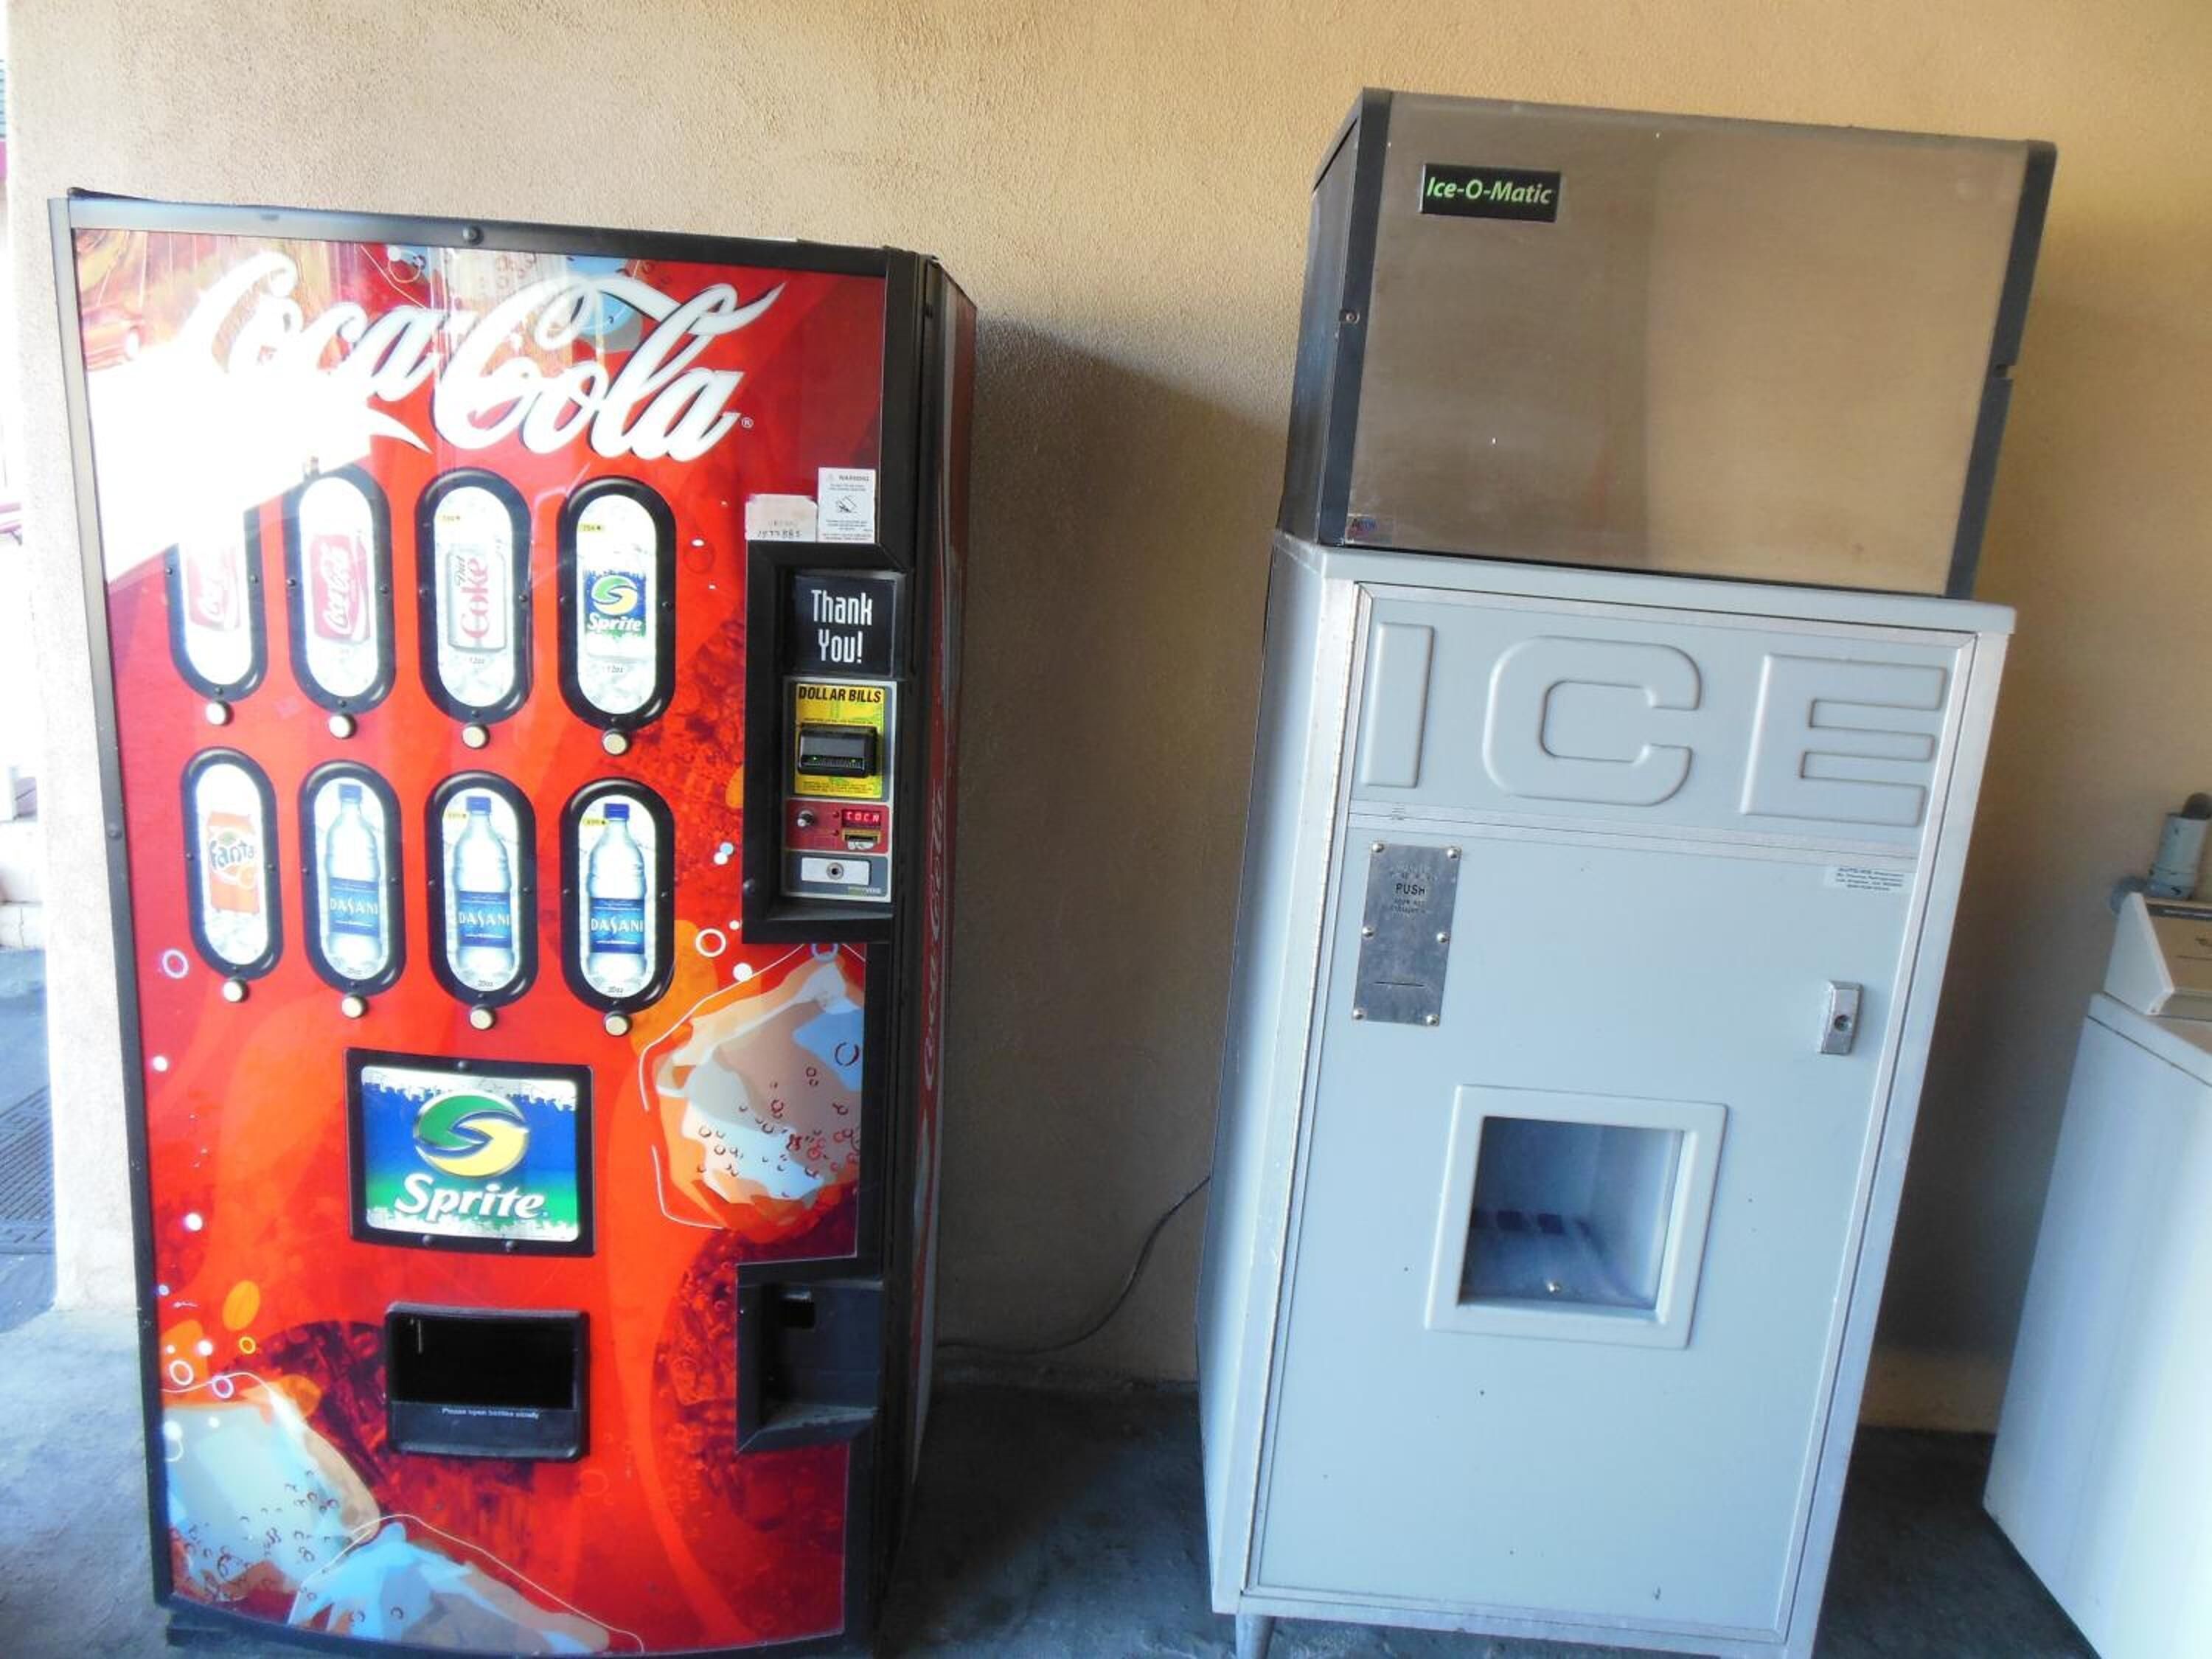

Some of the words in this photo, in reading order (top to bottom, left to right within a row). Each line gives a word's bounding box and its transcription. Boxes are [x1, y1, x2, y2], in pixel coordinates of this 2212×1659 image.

[1426, 176, 1553, 205] Ice-O-Matic
[459, 558, 490, 639] Coke
[811, 589, 873, 626] Thank
[586, 612, 642, 633] Sprite
[818, 628, 863, 664] You!
[798, 686, 846, 700] DOLLAR
[849, 689, 882, 703] BILLS
[1361, 622, 1947, 829] ICE
[209, 840, 256, 869] Fanta
[1395, 882, 1426, 897] PUSH
[330, 897, 378, 916] DASANI
[458, 911, 510, 928] DASANI
[591, 916, 644, 934] DASANI
[394, 1172, 546, 1222] Sprite
